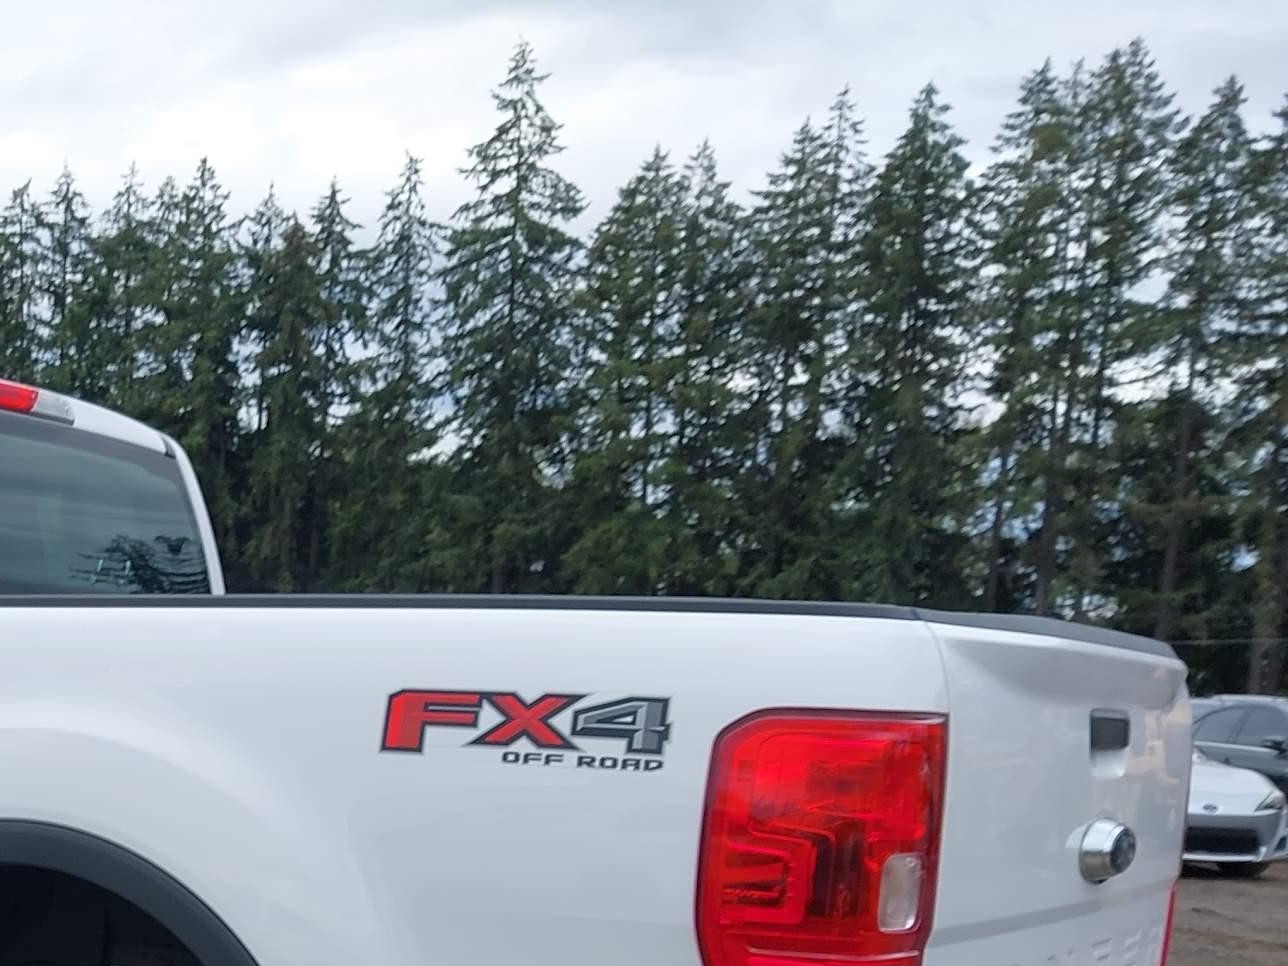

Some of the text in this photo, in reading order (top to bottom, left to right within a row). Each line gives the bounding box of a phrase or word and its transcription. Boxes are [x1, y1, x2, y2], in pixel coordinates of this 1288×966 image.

[379, 688, 673, 755] FX4
[500, 751, 665, 772] OFF ROAD
